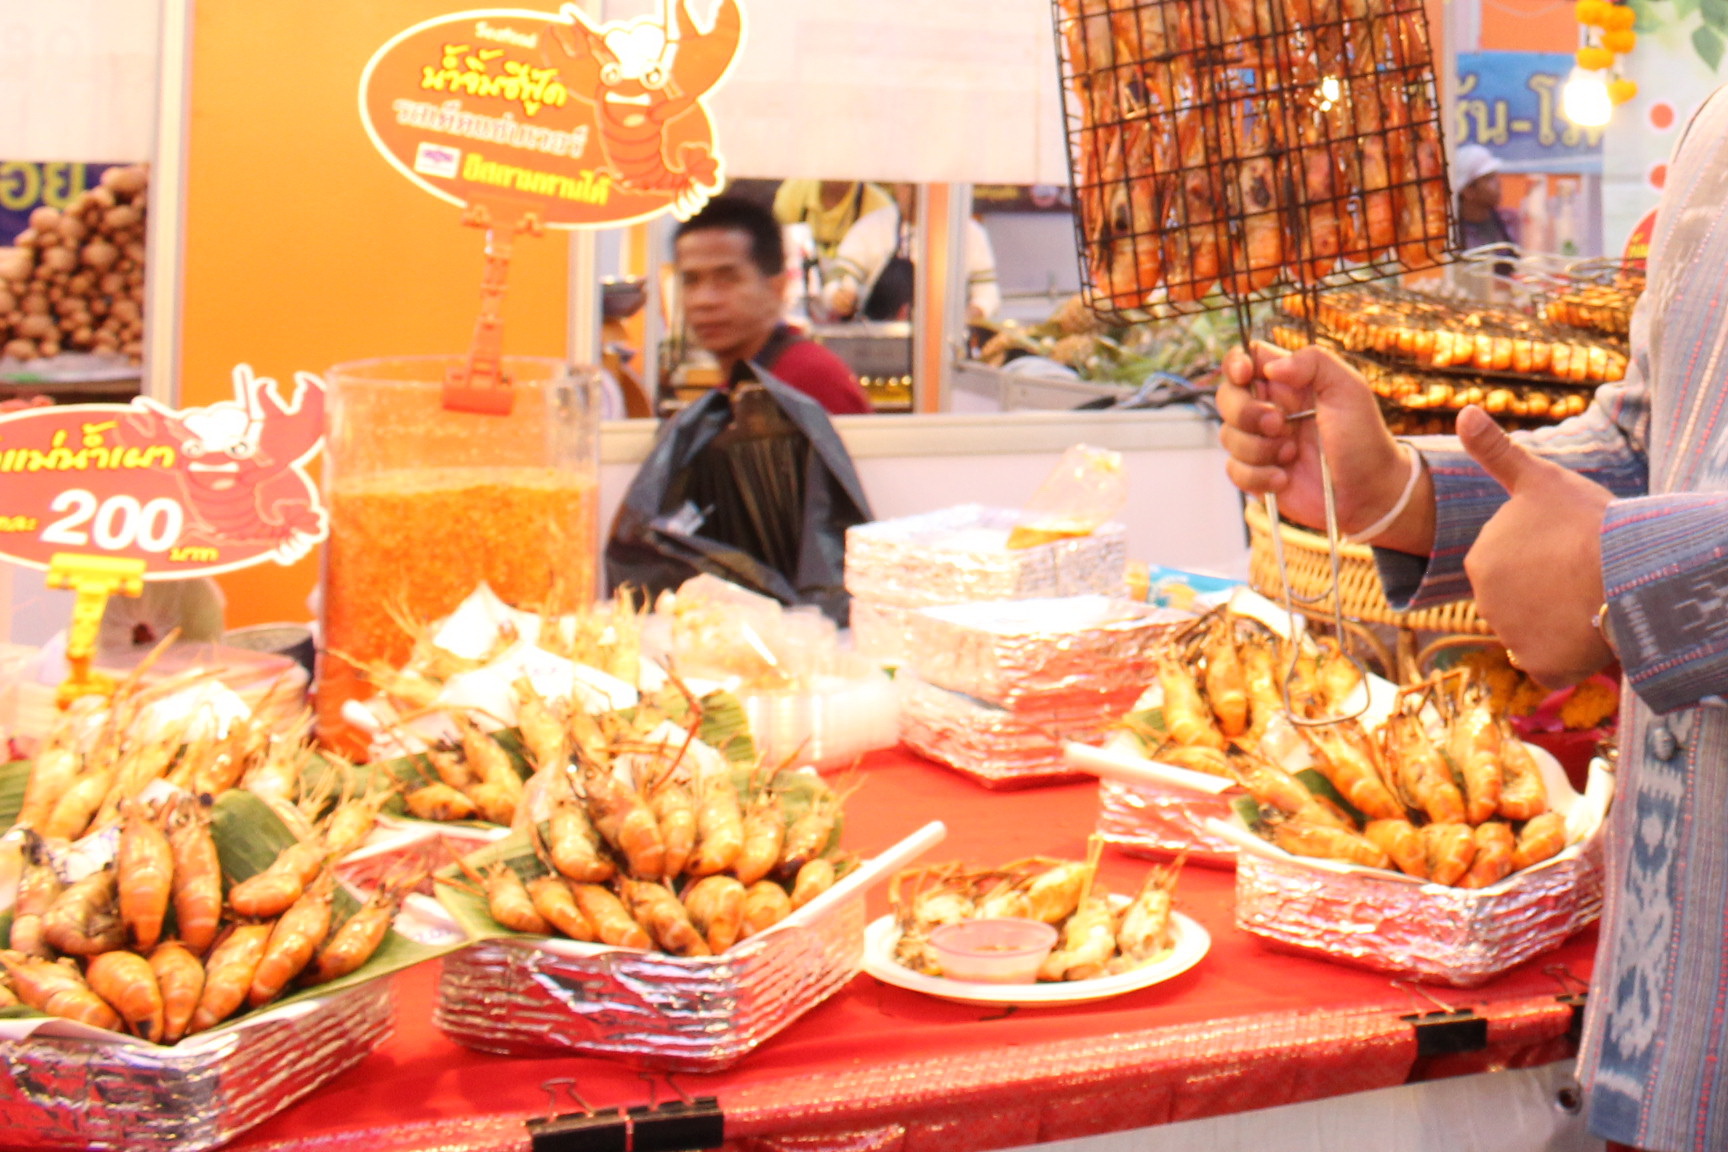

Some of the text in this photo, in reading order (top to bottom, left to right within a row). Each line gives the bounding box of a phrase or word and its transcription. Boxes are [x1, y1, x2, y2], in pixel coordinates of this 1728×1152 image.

[0, 420, 176, 473] แม่น้ำเผา
[40, 488, 184, 553] 200
